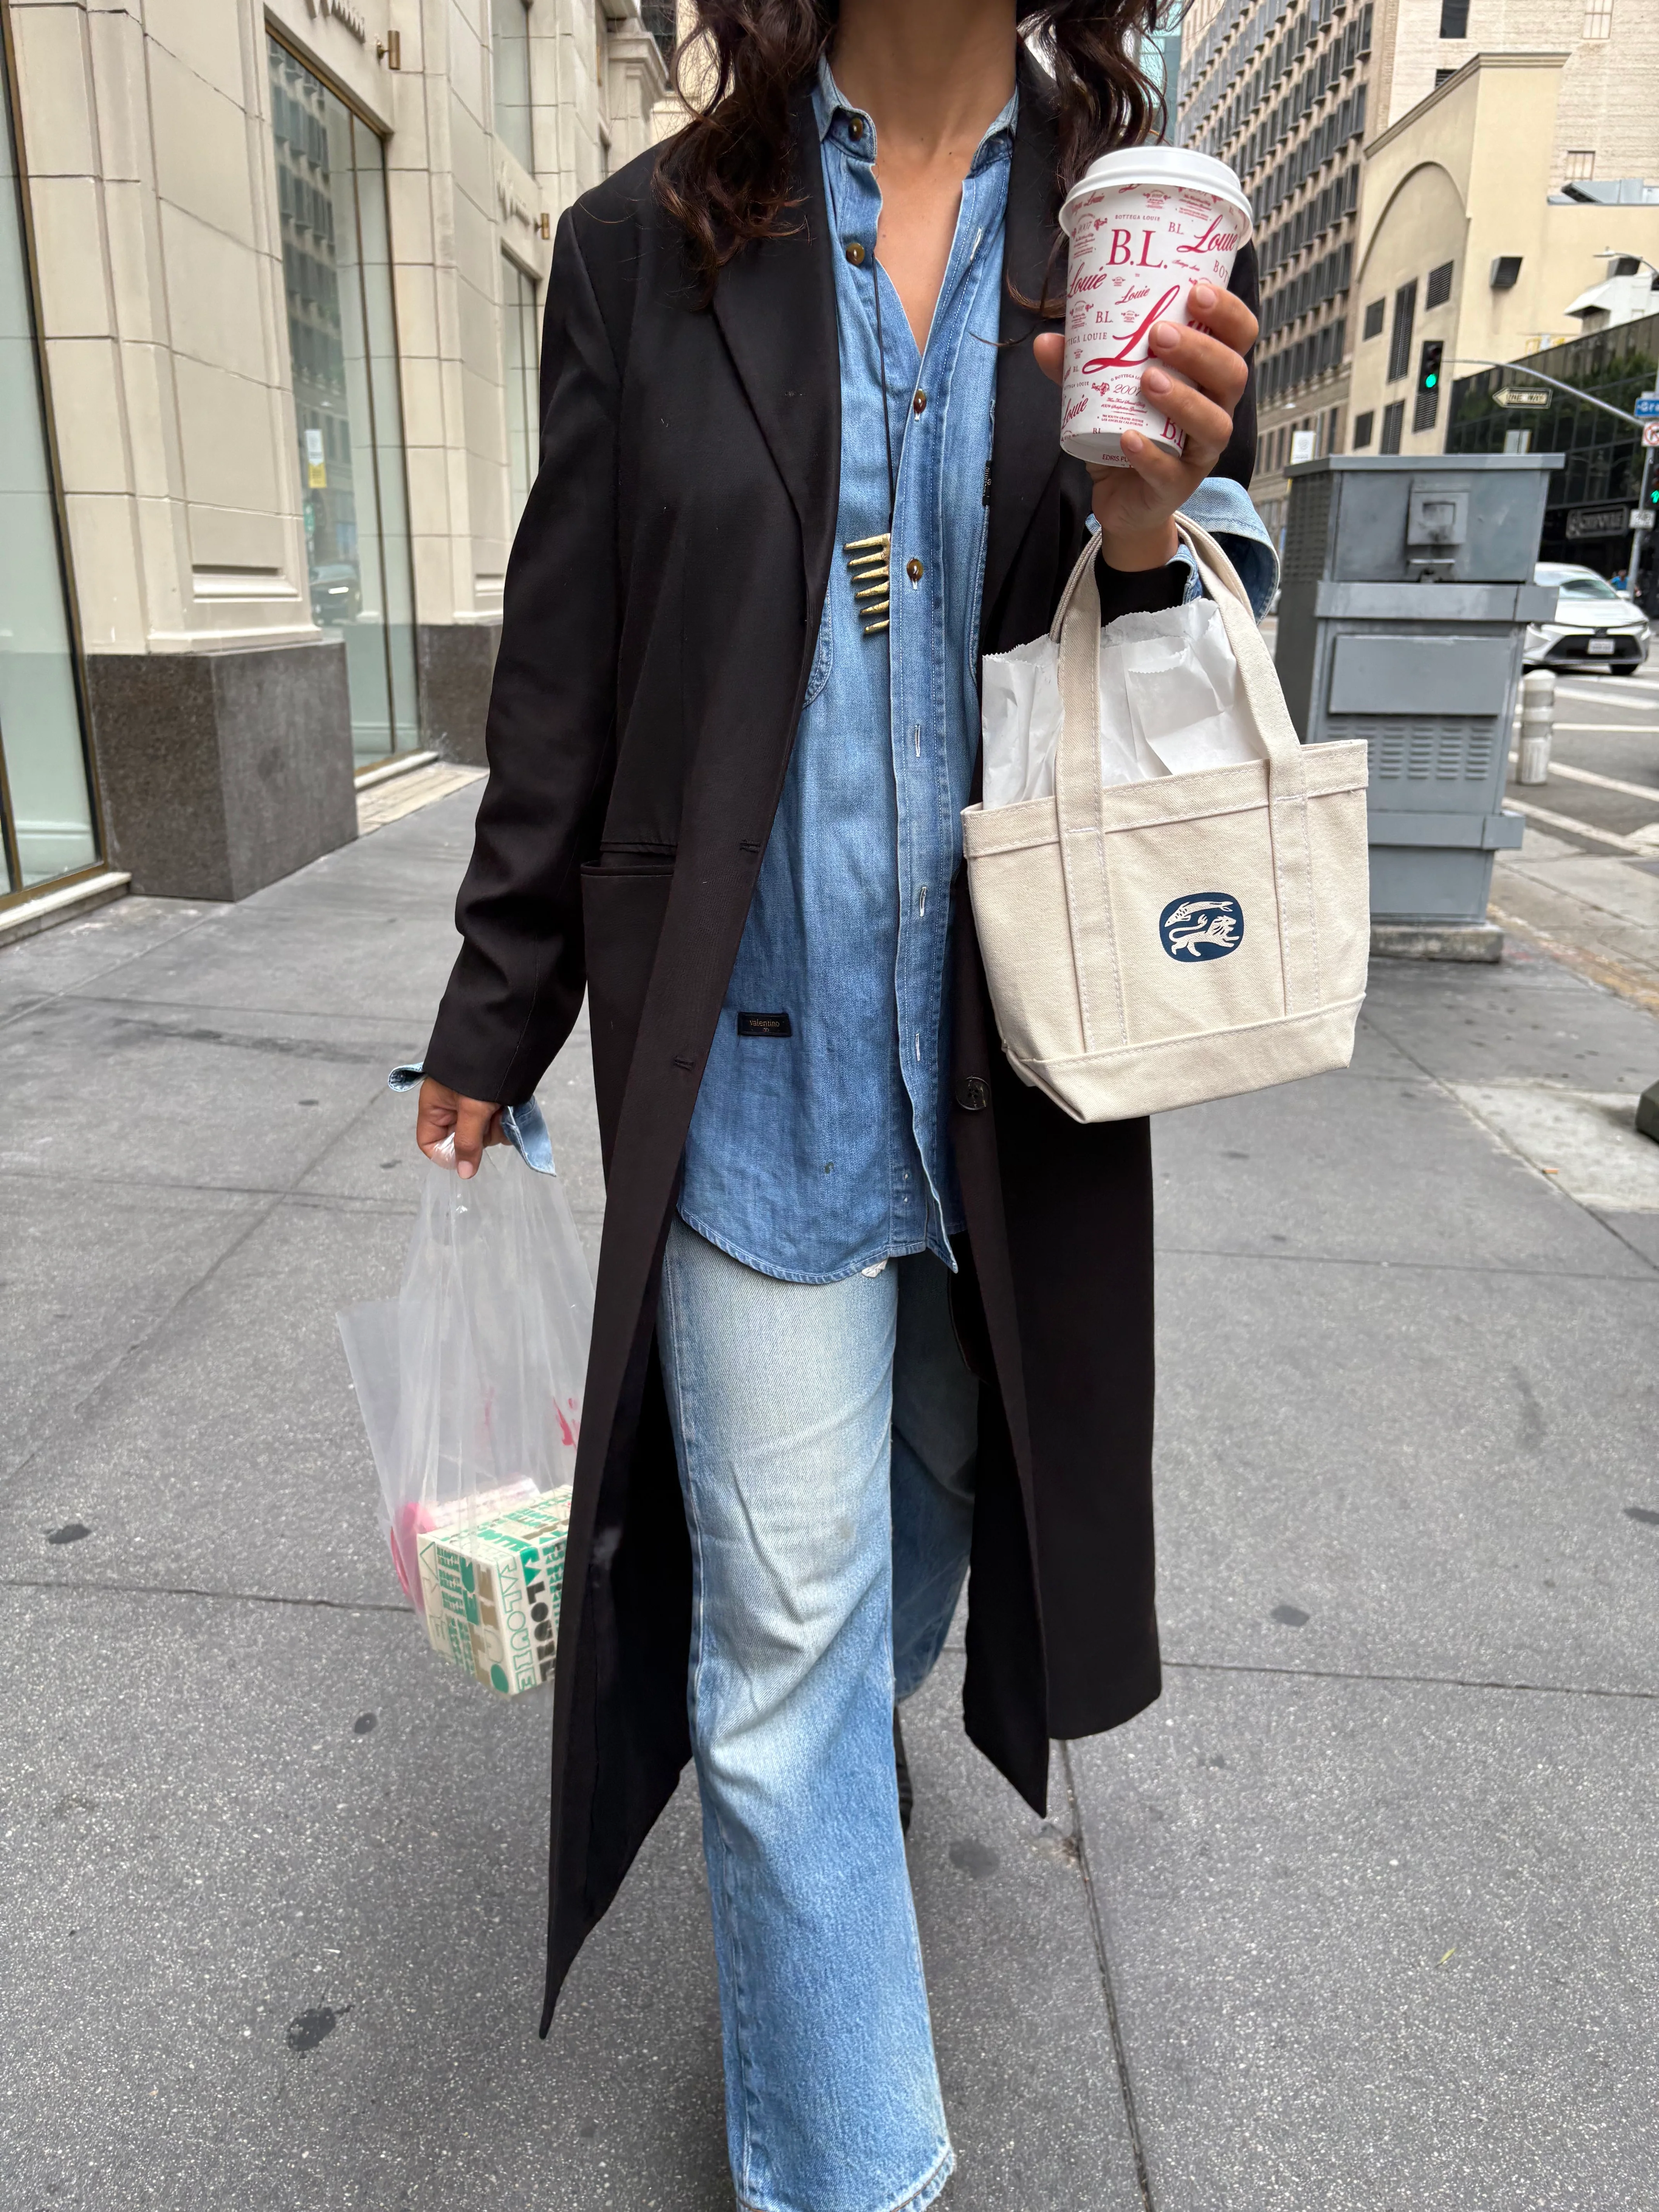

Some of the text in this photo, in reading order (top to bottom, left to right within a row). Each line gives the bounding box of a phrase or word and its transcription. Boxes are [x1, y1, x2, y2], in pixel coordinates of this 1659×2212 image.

[1106, 229, 1167, 269] B.L.
[1176, 215, 1238, 253] Louie
[1067, 262, 1107, 298] Louie
[1115, 285, 1150, 305] Louie
[1083, 332, 1107, 342] LOUIE
